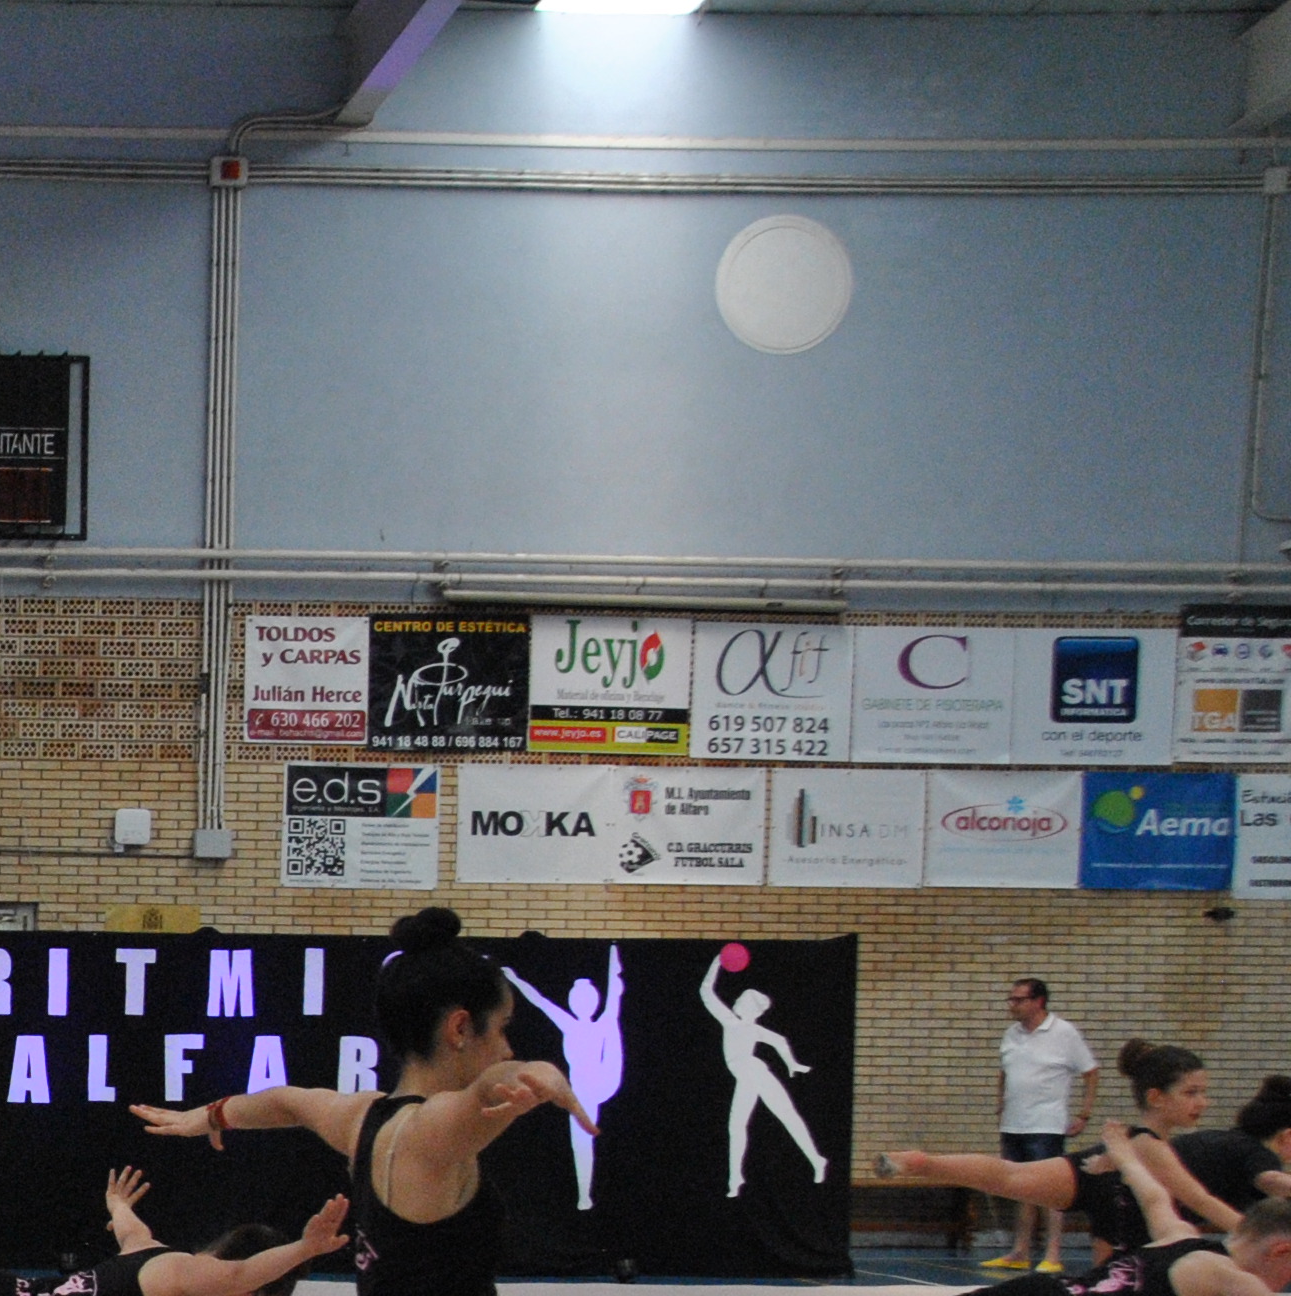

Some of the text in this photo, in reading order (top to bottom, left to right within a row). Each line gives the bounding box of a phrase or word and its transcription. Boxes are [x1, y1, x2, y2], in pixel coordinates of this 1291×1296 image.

[255, 626, 336, 642] TOLDOS
[374, 620, 526, 633] CENTRO DE ESTÉTICA
[261, 648, 361, 667] y CARPAS
[253, 685, 362, 703] Julián Herce
[1060, 678, 1130, 705] SNT
[271, 712, 361, 728] 630 466 202
[582, 709, 605, 719] 941
[610, 709, 625, 720] 18
[628, 710, 643, 720] 08
[648, 711, 663, 721] 77
[709, 715, 830, 734] 619 507 824
[372, 736, 393, 747] 941
[396, 736, 411, 747] 18
[455, 736, 476, 748] 696
[503, 737, 523, 748] 167
[1041, 730, 1143, 743] con el deporte
[708, 737, 829, 756] 657 315 422
[292, 771, 382, 804] e.d.s
[688, 787, 751, 802] Ayuntamiento
[1242, 789, 1291, 804] Estaci
[665, 803, 710, 816] de Alfaro
[1240, 810, 1278, 827] Las
[674, 857, 745, 868] FUTBOL SALA
[7, 1033, 380, 1104] ALFAR
